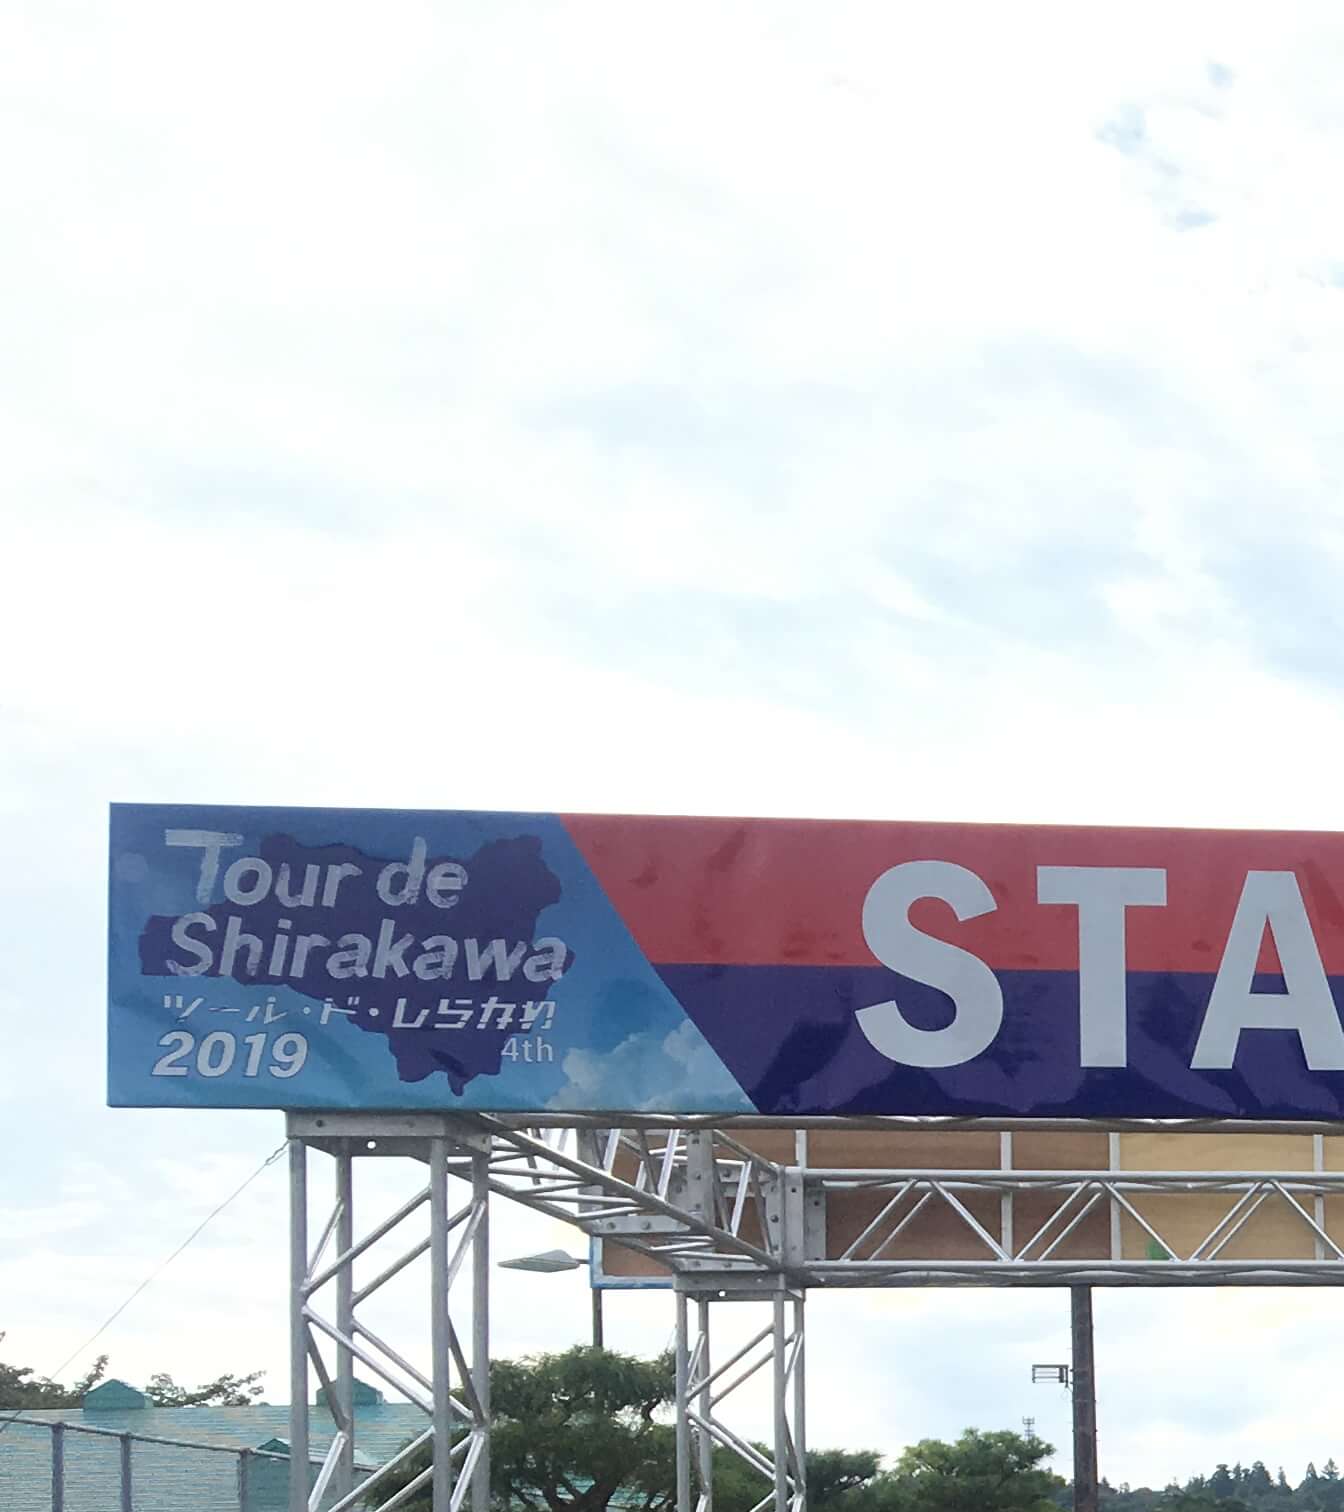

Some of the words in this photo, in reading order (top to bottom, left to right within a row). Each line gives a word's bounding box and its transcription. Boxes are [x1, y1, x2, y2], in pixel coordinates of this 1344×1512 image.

[164, 829, 361, 907] Tour
[376, 836, 468, 908] de
[169, 913, 567, 981] Shirakawa
[152, 1031, 308, 1078] 2019
[502, 1036, 553, 1062] 4th
